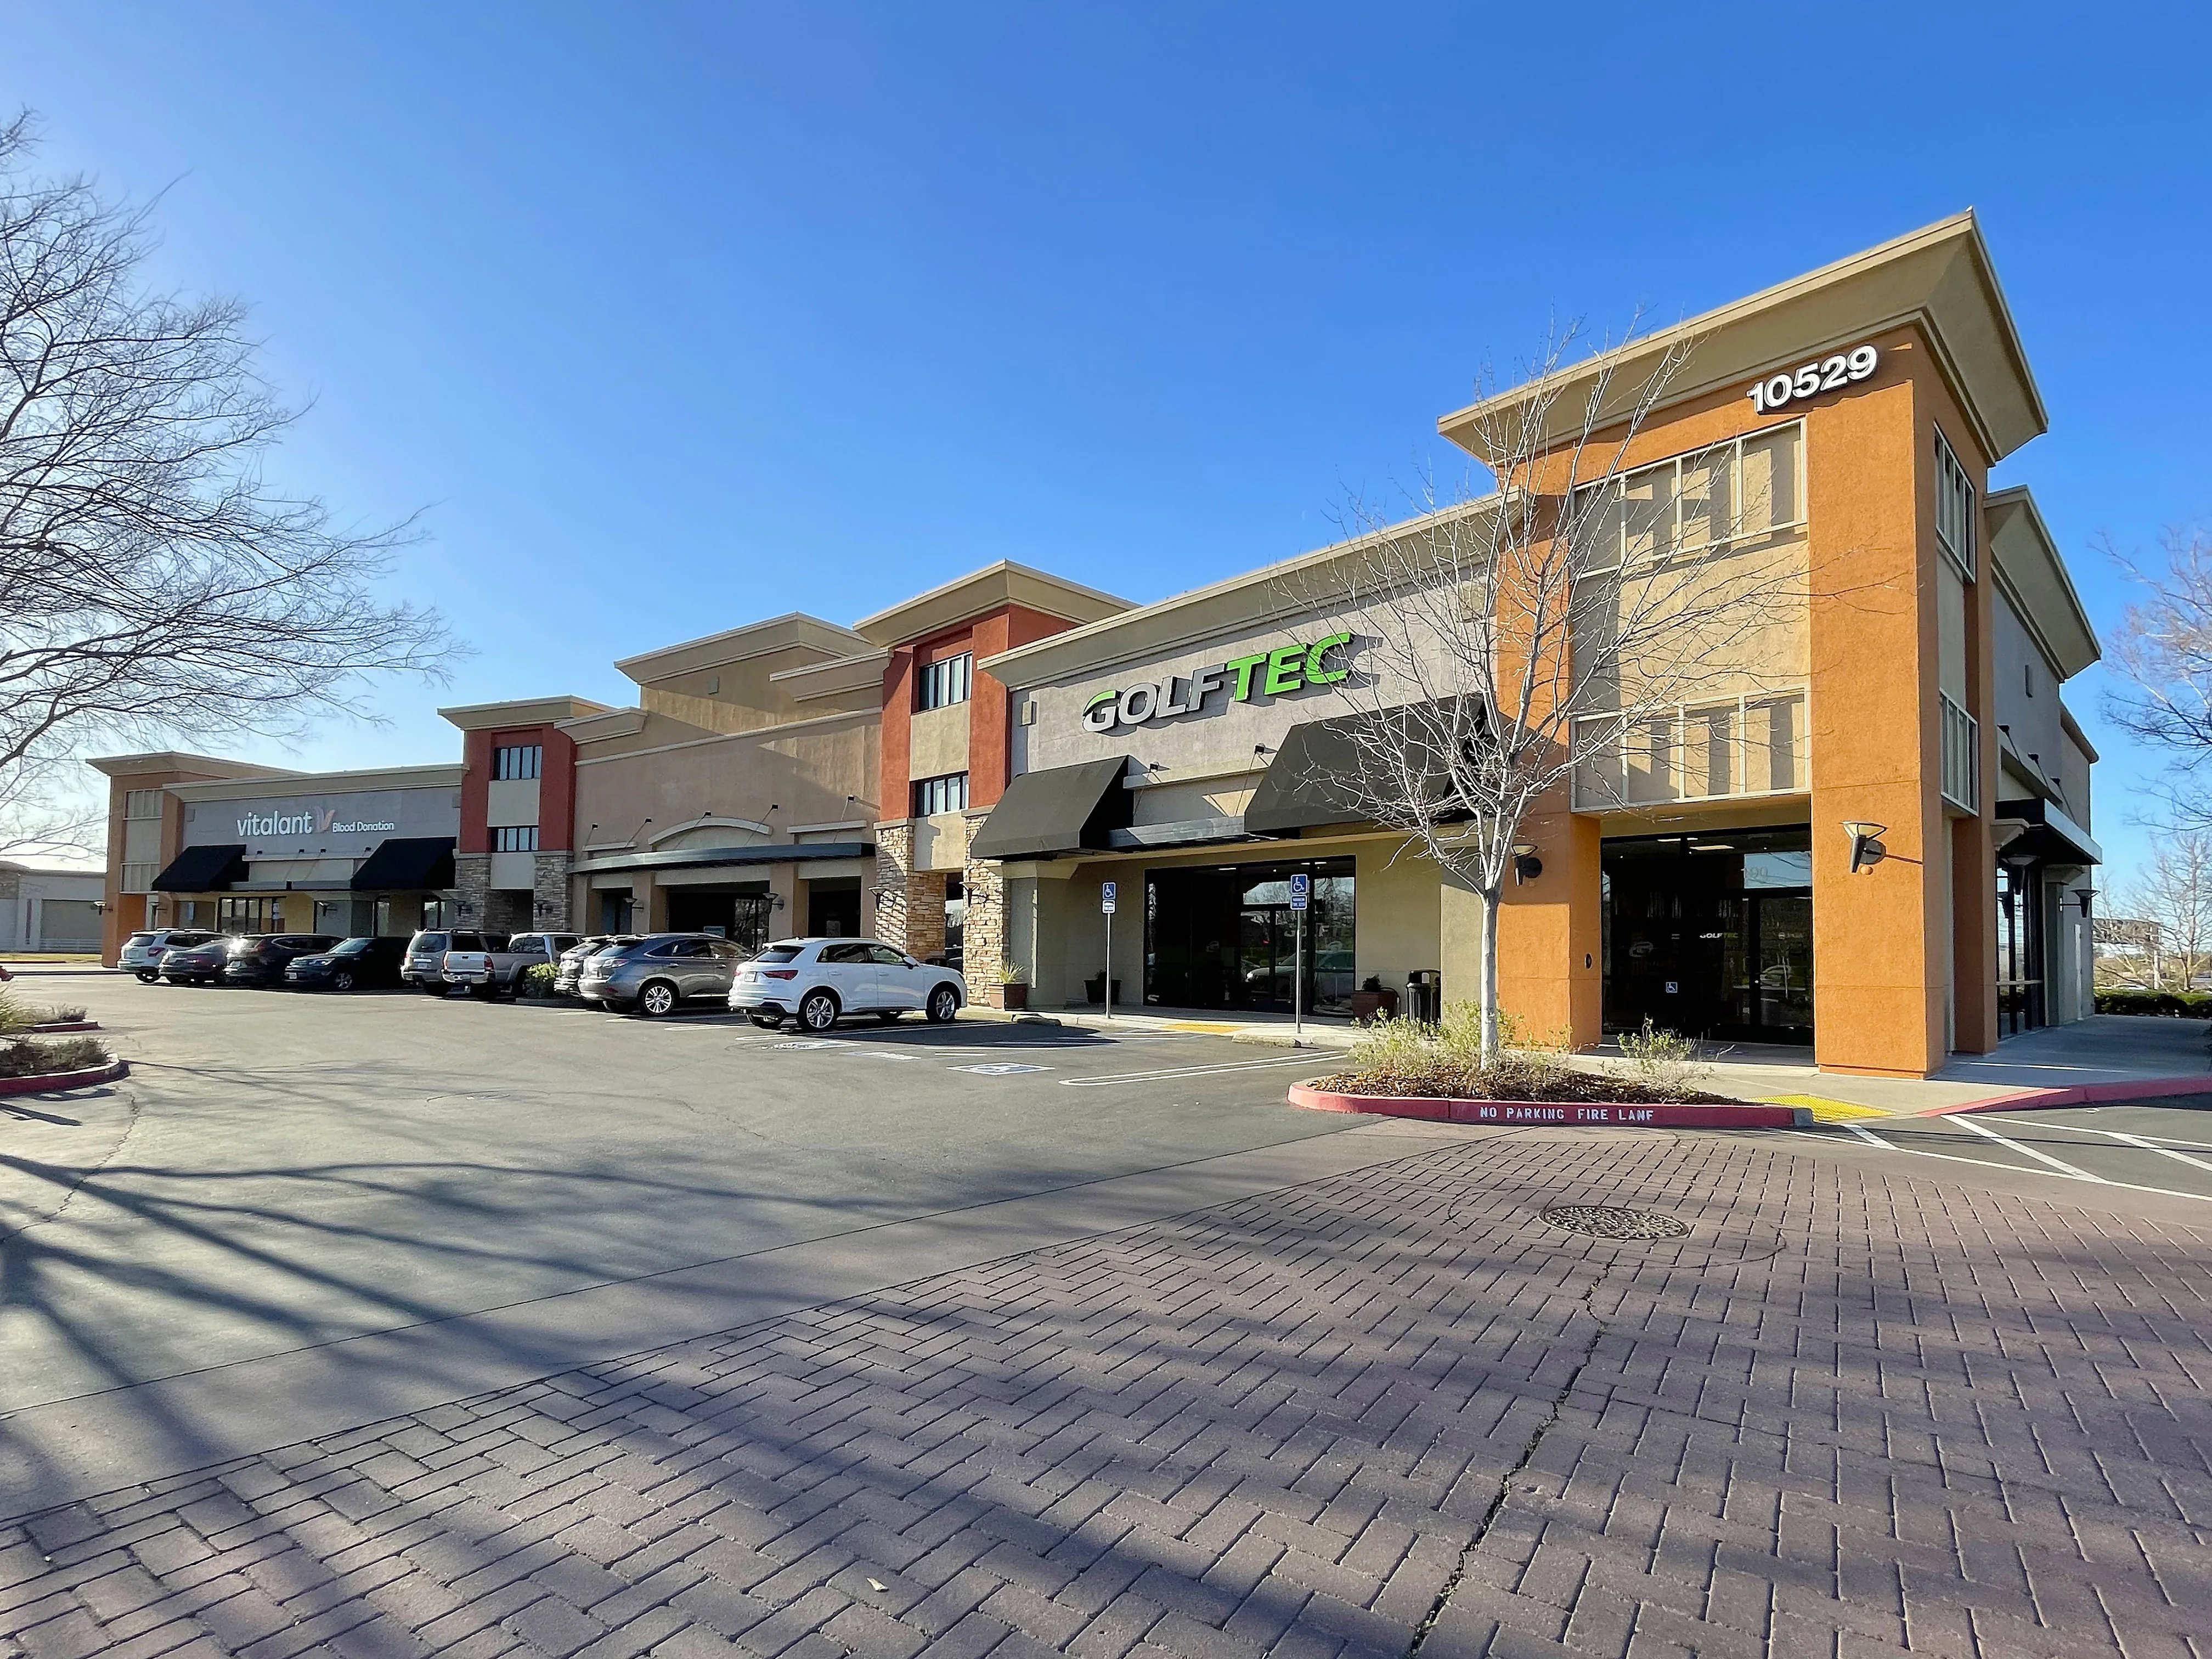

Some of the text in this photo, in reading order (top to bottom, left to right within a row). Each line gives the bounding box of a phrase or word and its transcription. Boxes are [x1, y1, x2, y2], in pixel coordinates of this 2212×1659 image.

[1746, 345, 1878, 413] 10529
[1082, 632, 1354, 732] GOLFTEC
[236, 810, 313, 837] vitalant
[332, 820, 394, 832] Blood Donation
[1480, 1107, 1497, 1118] NO
[1506, 1107, 1564, 1119] PARKING
[1577, 1108, 1609, 1120] FIRE
